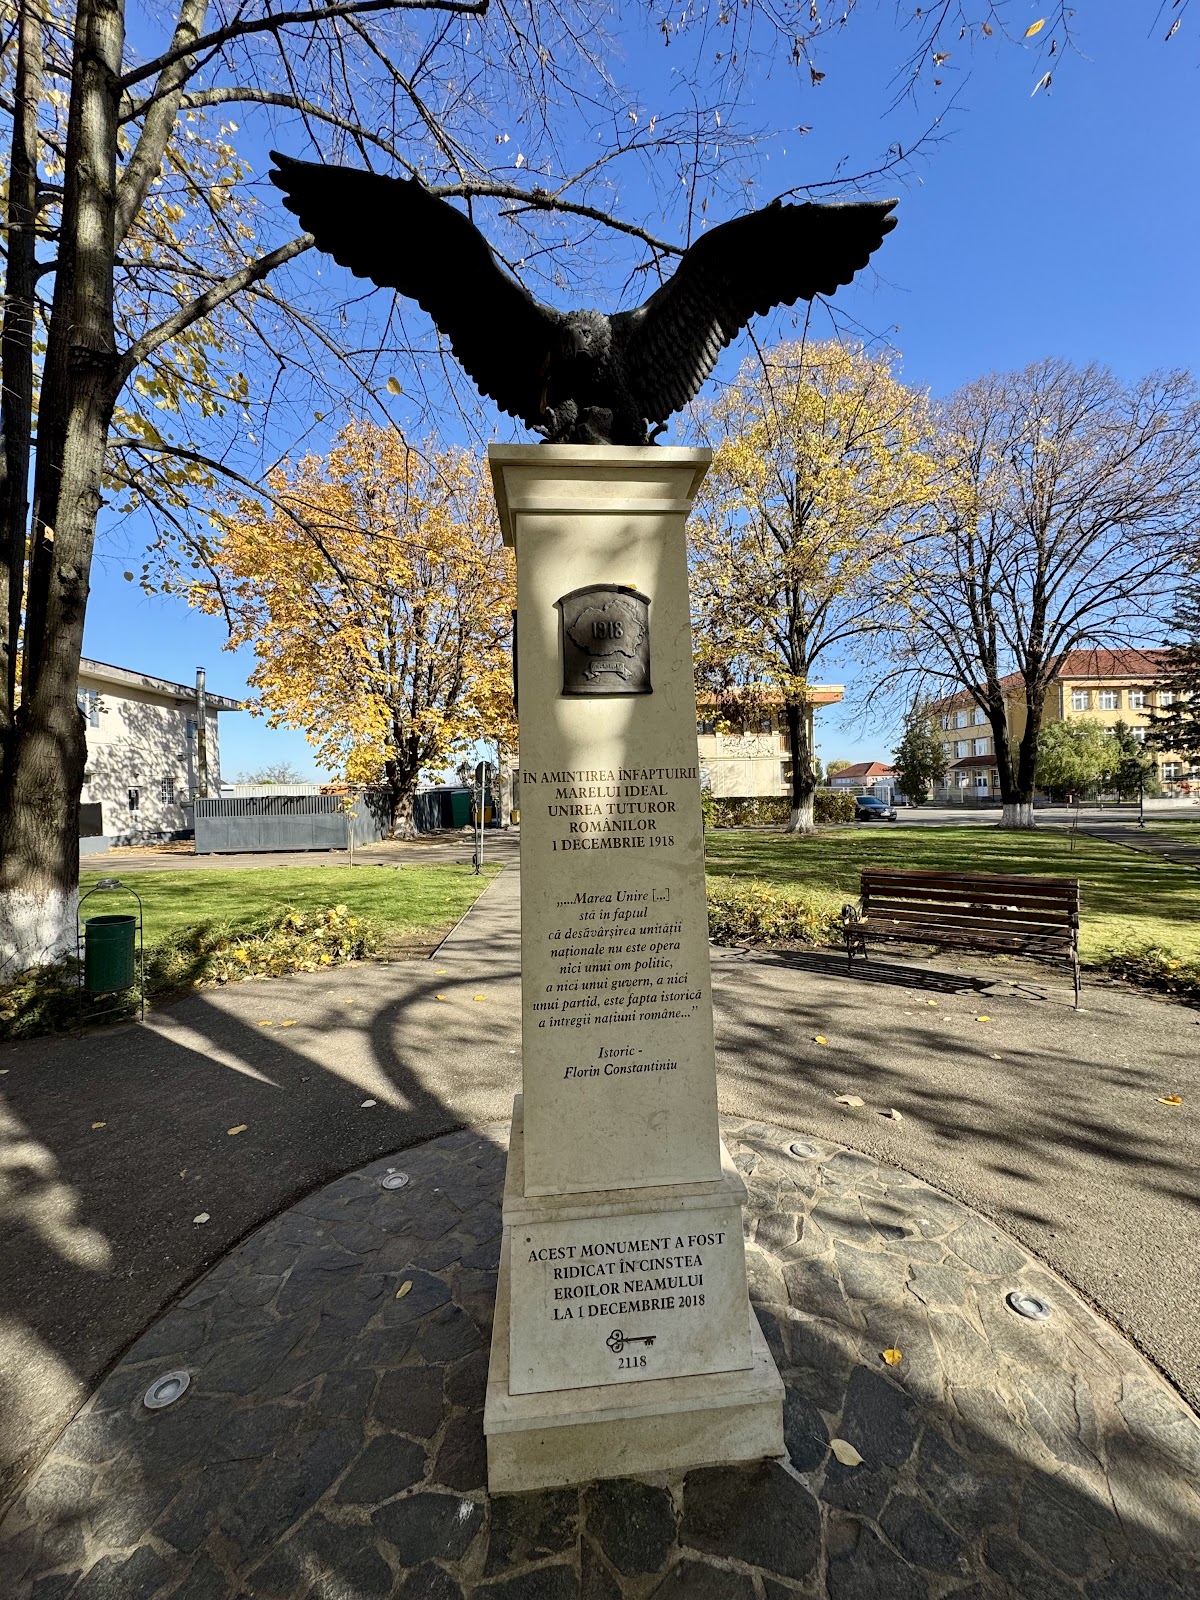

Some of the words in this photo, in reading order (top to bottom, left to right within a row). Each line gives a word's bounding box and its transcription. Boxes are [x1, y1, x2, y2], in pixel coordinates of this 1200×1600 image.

[592, 621, 624, 640] 1918
[523, 769, 537, 784] ÎN
[541, 770, 616, 784] AMINTIREA
[555, 785, 621, 800] MARELUI
[625, 784, 668, 797] IDEAL
[548, 804, 602, 817] UNIREA
[606, 801, 676, 815] TUTUROR
[569, 818, 657, 834] ROMÂNILOR
[552, 840, 557, 851] 1
[561, 836, 645, 851] DECEMBRIE
[649, 835, 675, 848] 1918
[616, 889, 649, 902] Unire
[579, 909, 596, 921] stă
[599, 909, 611, 920] în
[612, 906, 648, 922] faptul
[548, 929, 561, 940] că
[608, 945, 623, 954] nu
[625, 943, 647, 953] este
[649, 942, 681, 954] opera
[560, 962, 581, 974] nici
[585, 960, 611, 973] unui
[614, 961, 632, 971] om
[633, 956, 673, 972] politic,
[546, 983, 553, 993] a
[556, 979, 578, 992] nici
[582, 977, 608, 990] unui
[610, 978, 653, 991] guvern,
[656, 978, 664, 986] a
[667, 972, 688, 985] nici
[532, 997, 559, 1011] unui
[561, 995, 600, 1012] partid,
[603, 997, 625, 1006] este
[626, 992, 657, 1008] fapta
[660, 988, 702, 1002] istorică
[538, 1019, 546, 1028] a
[549, 1013, 591, 1028] întregii
[598, 1045, 635, 1059] Istoric
[563, 1065, 600, 1079] Florin
[603, 1059, 678, 1076] Constantiniu
[528, 1246, 577, 1263] ACEST
[580, 1237, 671, 1258] MONUMENT
[675, 1236, 685, 1249] A
[688, 1232, 726, 1247] FOST
[553, 1262, 615, 1280] RIDICAT
[620, 1258, 635, 1274] ÎN
[639, 1254, 703, 1272] CINSTEA
[554, 1282, 619, 1300] EROILOR
[624, 1274, 703, 1295] NEAMULUI
[553, 1307, 573, 1320] LA
[578, 1305, 584, 1318] 1
[588, 1295, 675, 1317] DECEMBRIE
[678, 1293, 705, 1308] 2018
[617, 1355, 647, 1370] 2118
